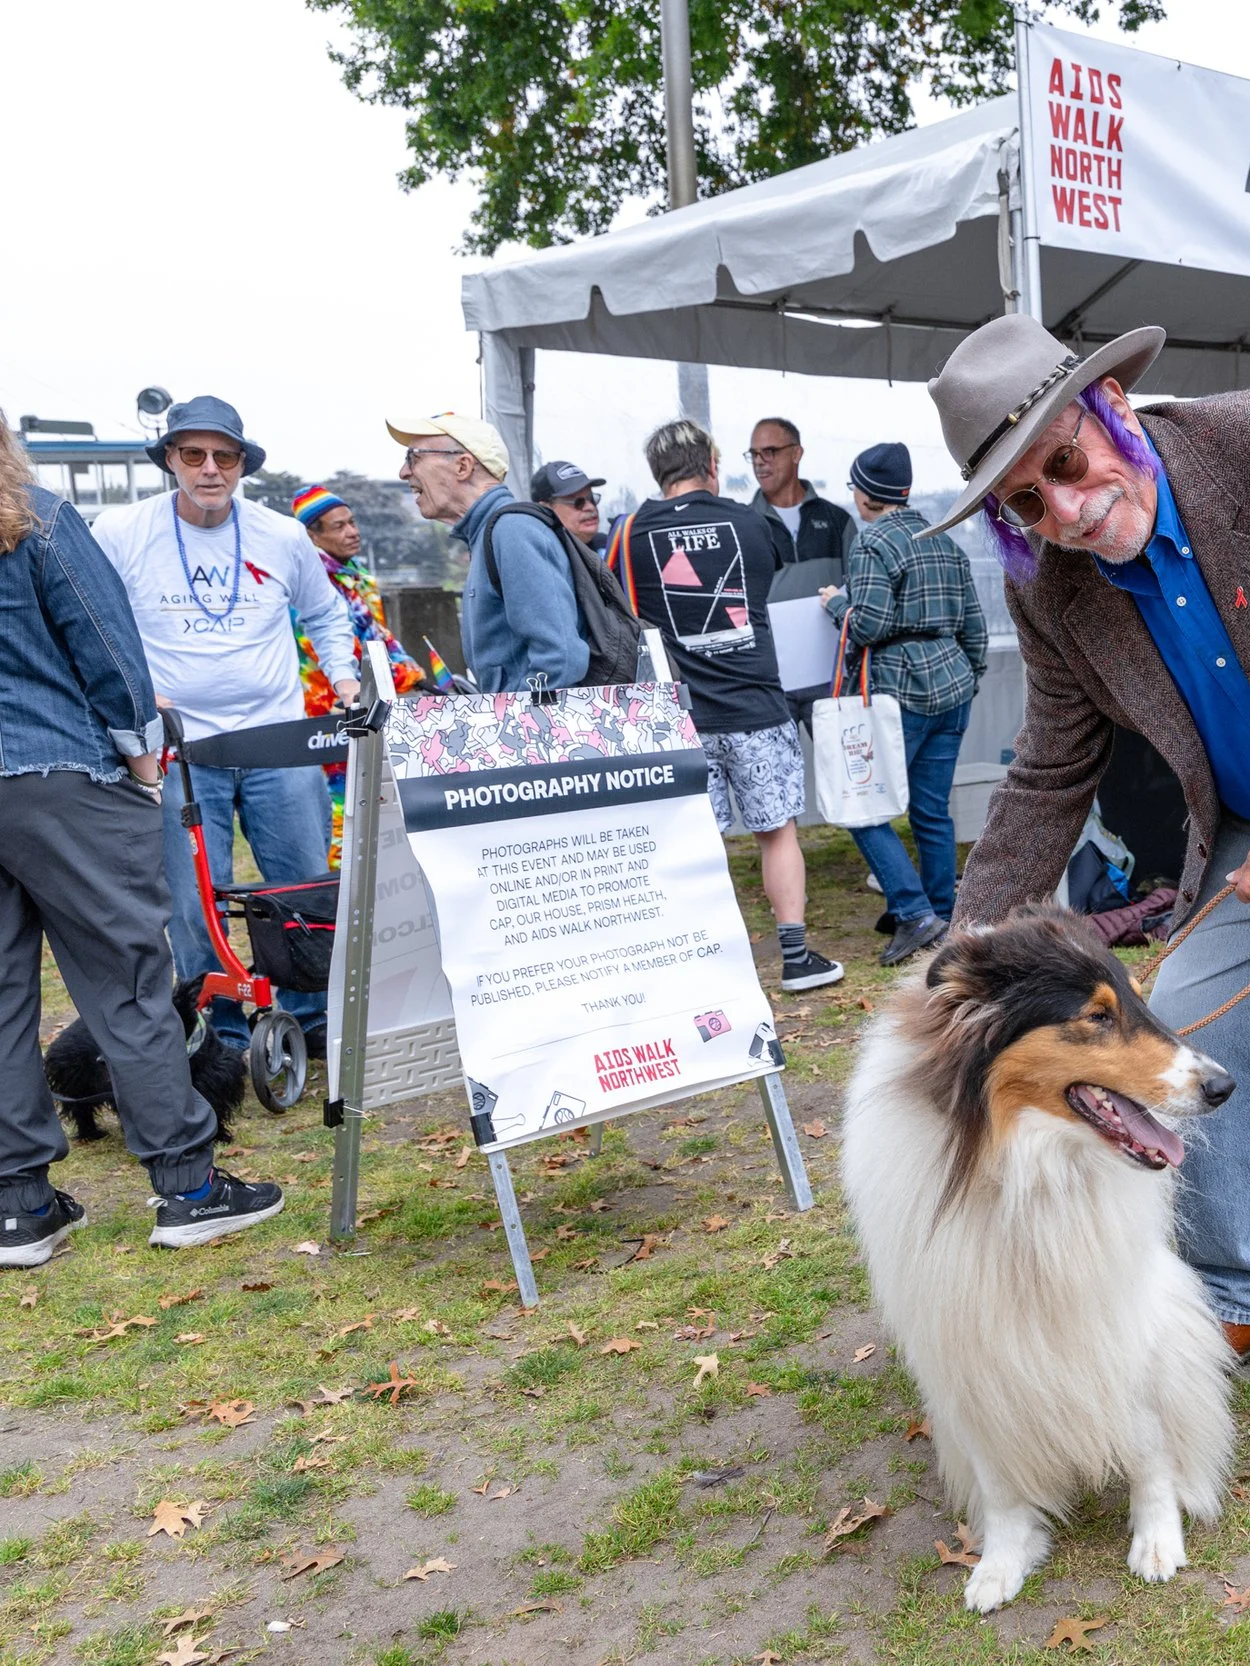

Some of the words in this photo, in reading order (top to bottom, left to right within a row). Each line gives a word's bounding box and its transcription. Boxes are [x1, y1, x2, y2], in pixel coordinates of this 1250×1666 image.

[1049, 57, 1122, 109] AIDS
[1049, 100, 1125, 153] WALK
[1050, 144, 1122, 191] NORTH
[1052, 184, 1122, 233] WEST
[667, 531, 682, 539] ALL
[682, 528, 706, 537] WALKS
[706, 527, 717, 535] OF
[668, 533, 721, 553] LIFE
[191, 565, 229, 587] AW
[159, 593, 212, 604] AGING
[219, 593, 259, 603] WELL
[308, 731, 349, 749] drive
[444, 773, 601, 810] PHOTOGRAPHY
[607, 764, 675, 791] NOTICE
[477, 866, 489, 878] AT
[491, 861, 519, 876] THIS
[522, 857, 557, 872] EVENT
[561, 853, 584, 866] AND
[587, 848, 610, 862] MAY
[613, 845, 627, 858] BE
[628, 841, 656, 855] USED
[482, 837, 568, 860] PHOTOGRAPHS
[571, 832, 597, 847] WILL
[600, 830, 614, 843] BE
[616, 825, 650, 840] TAKEN
[490, 879, 532, 895] ONLINE
[535, 871, 578, 888] AND/OR
[581, 869, 592, 881] IN
[594, 863, 625, 878] PRINT
[627, 859, 649, 872] AND
[496, 896, 540, 912] DIGITAL
[542, 890, 578, 905] MEDIA
[580, 886, 596, 898] TO
[598, 876, 650, 894] PROMOTE
[489, 917, 515, 931] CAP,
[516, 912, 542, 926] OUR
[544, 905, 586, 921] HOUSE,
[587, 898, 621, 914] PRISM
[623, 890, 668, 907] HEALTH,
[504, 934, 528, 946] AND
[531, 928, 557, 942] AIDS
[560, 921, 592, 936] WALK
[594, 907, 664, 929] NORTHWEST.
[471, 986, 535, 1007] PUBLISHED,
[536, 975, 580, 993] PLEASE
[581, 965, 621, 982] NOTIFY
[623, 963, 632, 974] A
[632, 953, 678, 972] MEMBER
[680, 949, 695, 962] OF
[697, 943, 723, 958] CAP.
[476, 975, 484, 987] IF
[485, 971, 510, 986] YOU
[512, 963, 555, 981] PREFER
[557, 956, 589, 971] YOUR
[591, 940, 666, 965] PHOTOGRAPH
[667, 935, 690, 949] NOT
[693, 930, 709, 941] BE
[581, 996, 620, 1014] THANK
[621, 992, 646, 1007] YOU!
[594, 1047, 632, 1073] AIDS
[631, 1038, 676, 1065] WALK
[598, 1059, 681, 1092] NORTHWEST
